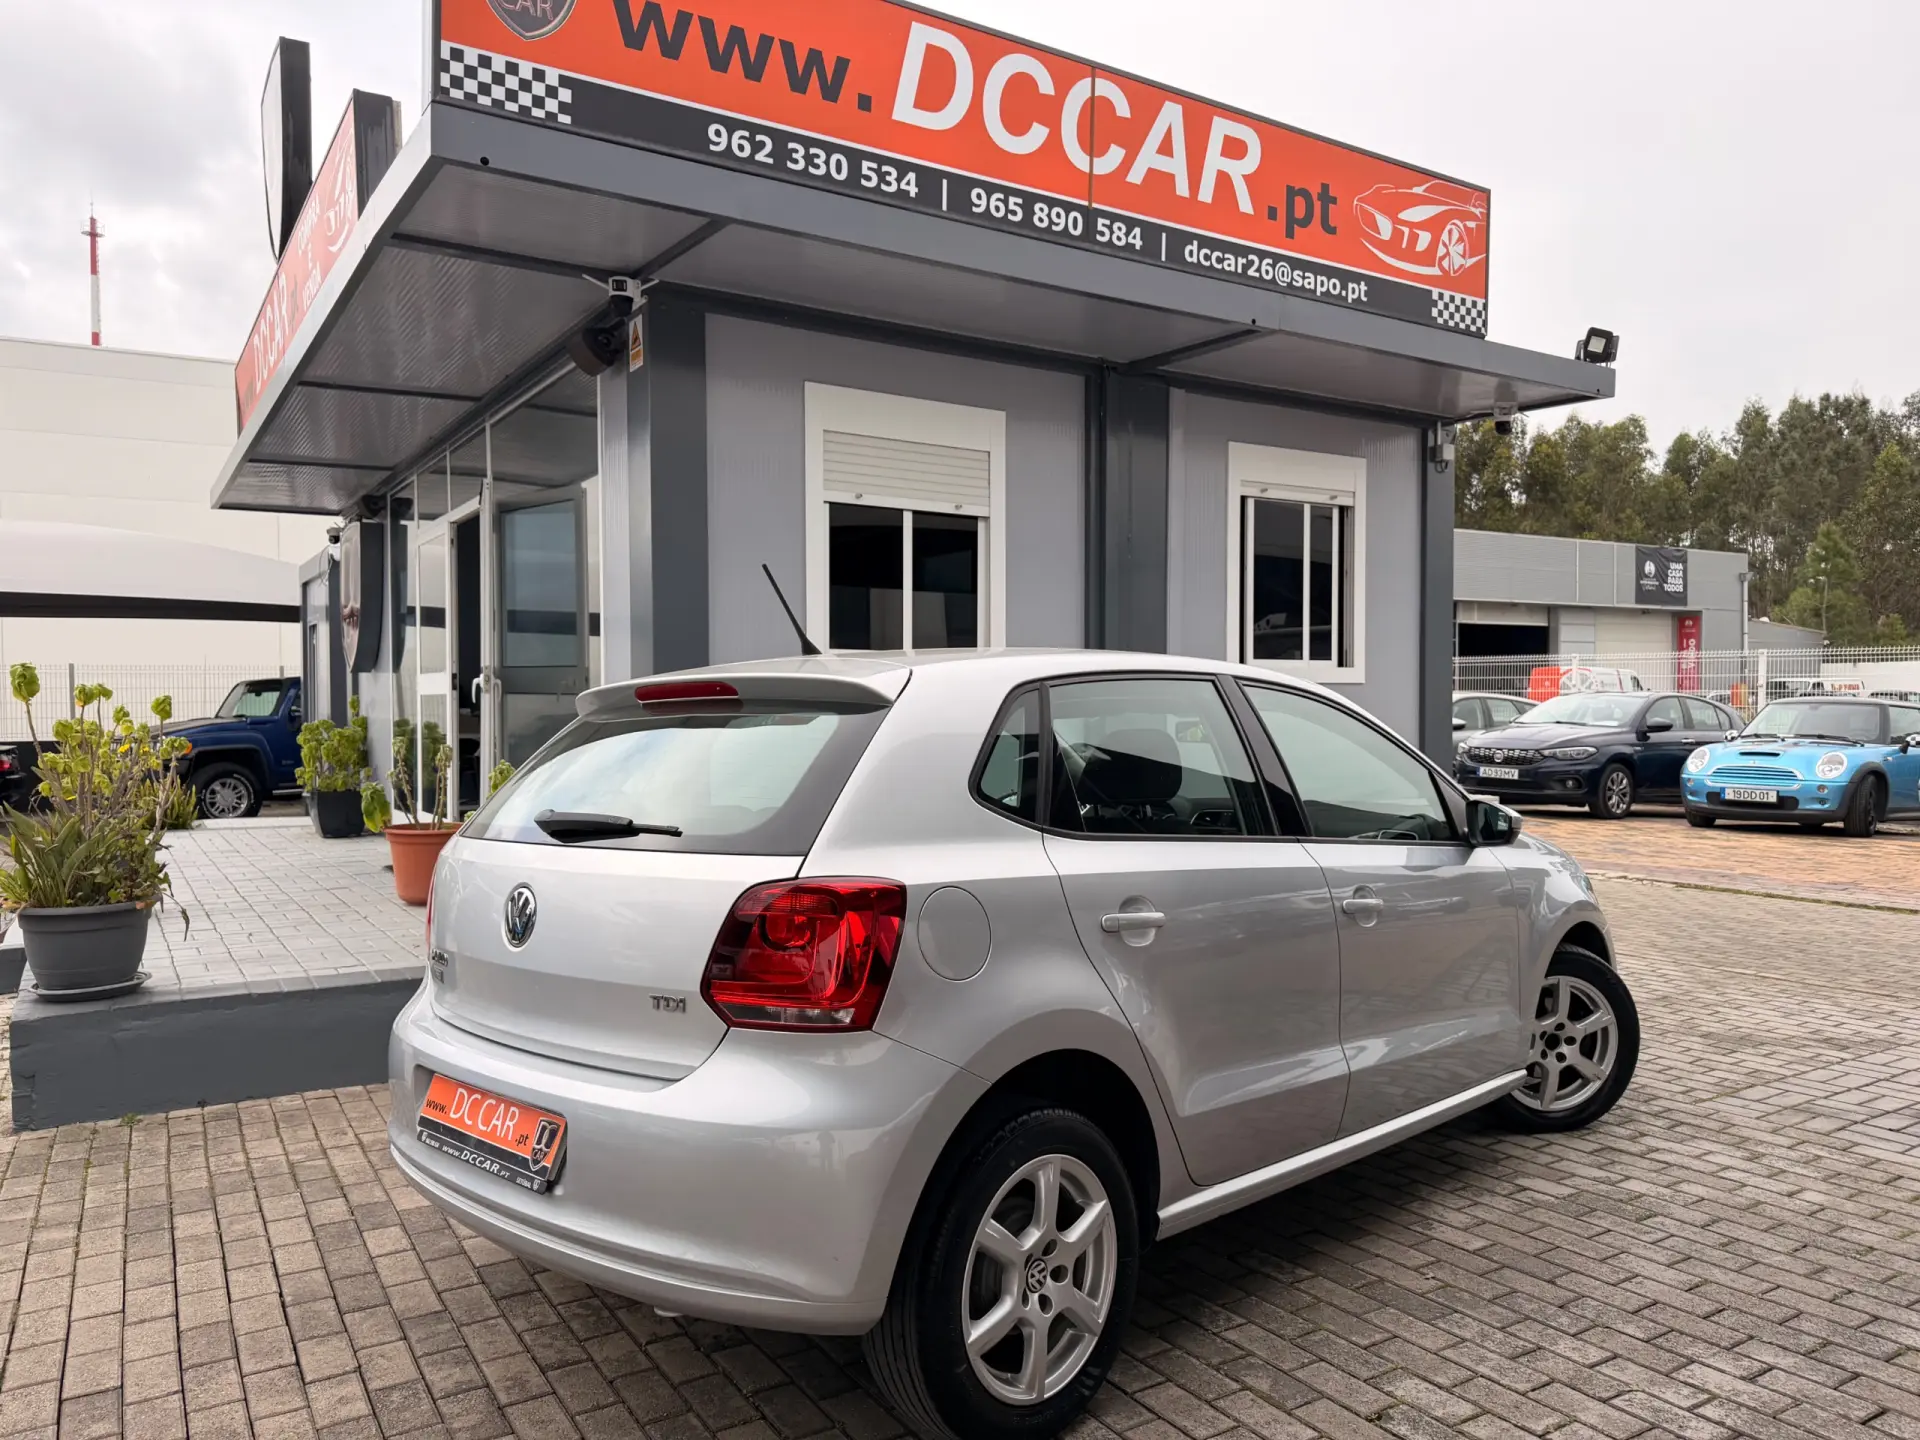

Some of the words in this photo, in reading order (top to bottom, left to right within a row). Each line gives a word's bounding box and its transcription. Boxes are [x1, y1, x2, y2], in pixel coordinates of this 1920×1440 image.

[707, 123, 774, 165] 962
[786, 142, 849, 182] 330
[860, 159, 919, 198] 534
[970, 187, 1024, 223] 965
[1032, 202, 1084, 237] 890
[1096, 217, 1144, 251] 584
[1184, 240, 1368, 302] dccar26@sapo.pt
[1669, 562, 1683, 570] UMA
[1668, 569, 1683, 577] CASA
[1668, 577, 1683, 585] PARA
[1663, 583, 1683, 592] TODOS
[649, 994, 686, 1013] TDI
